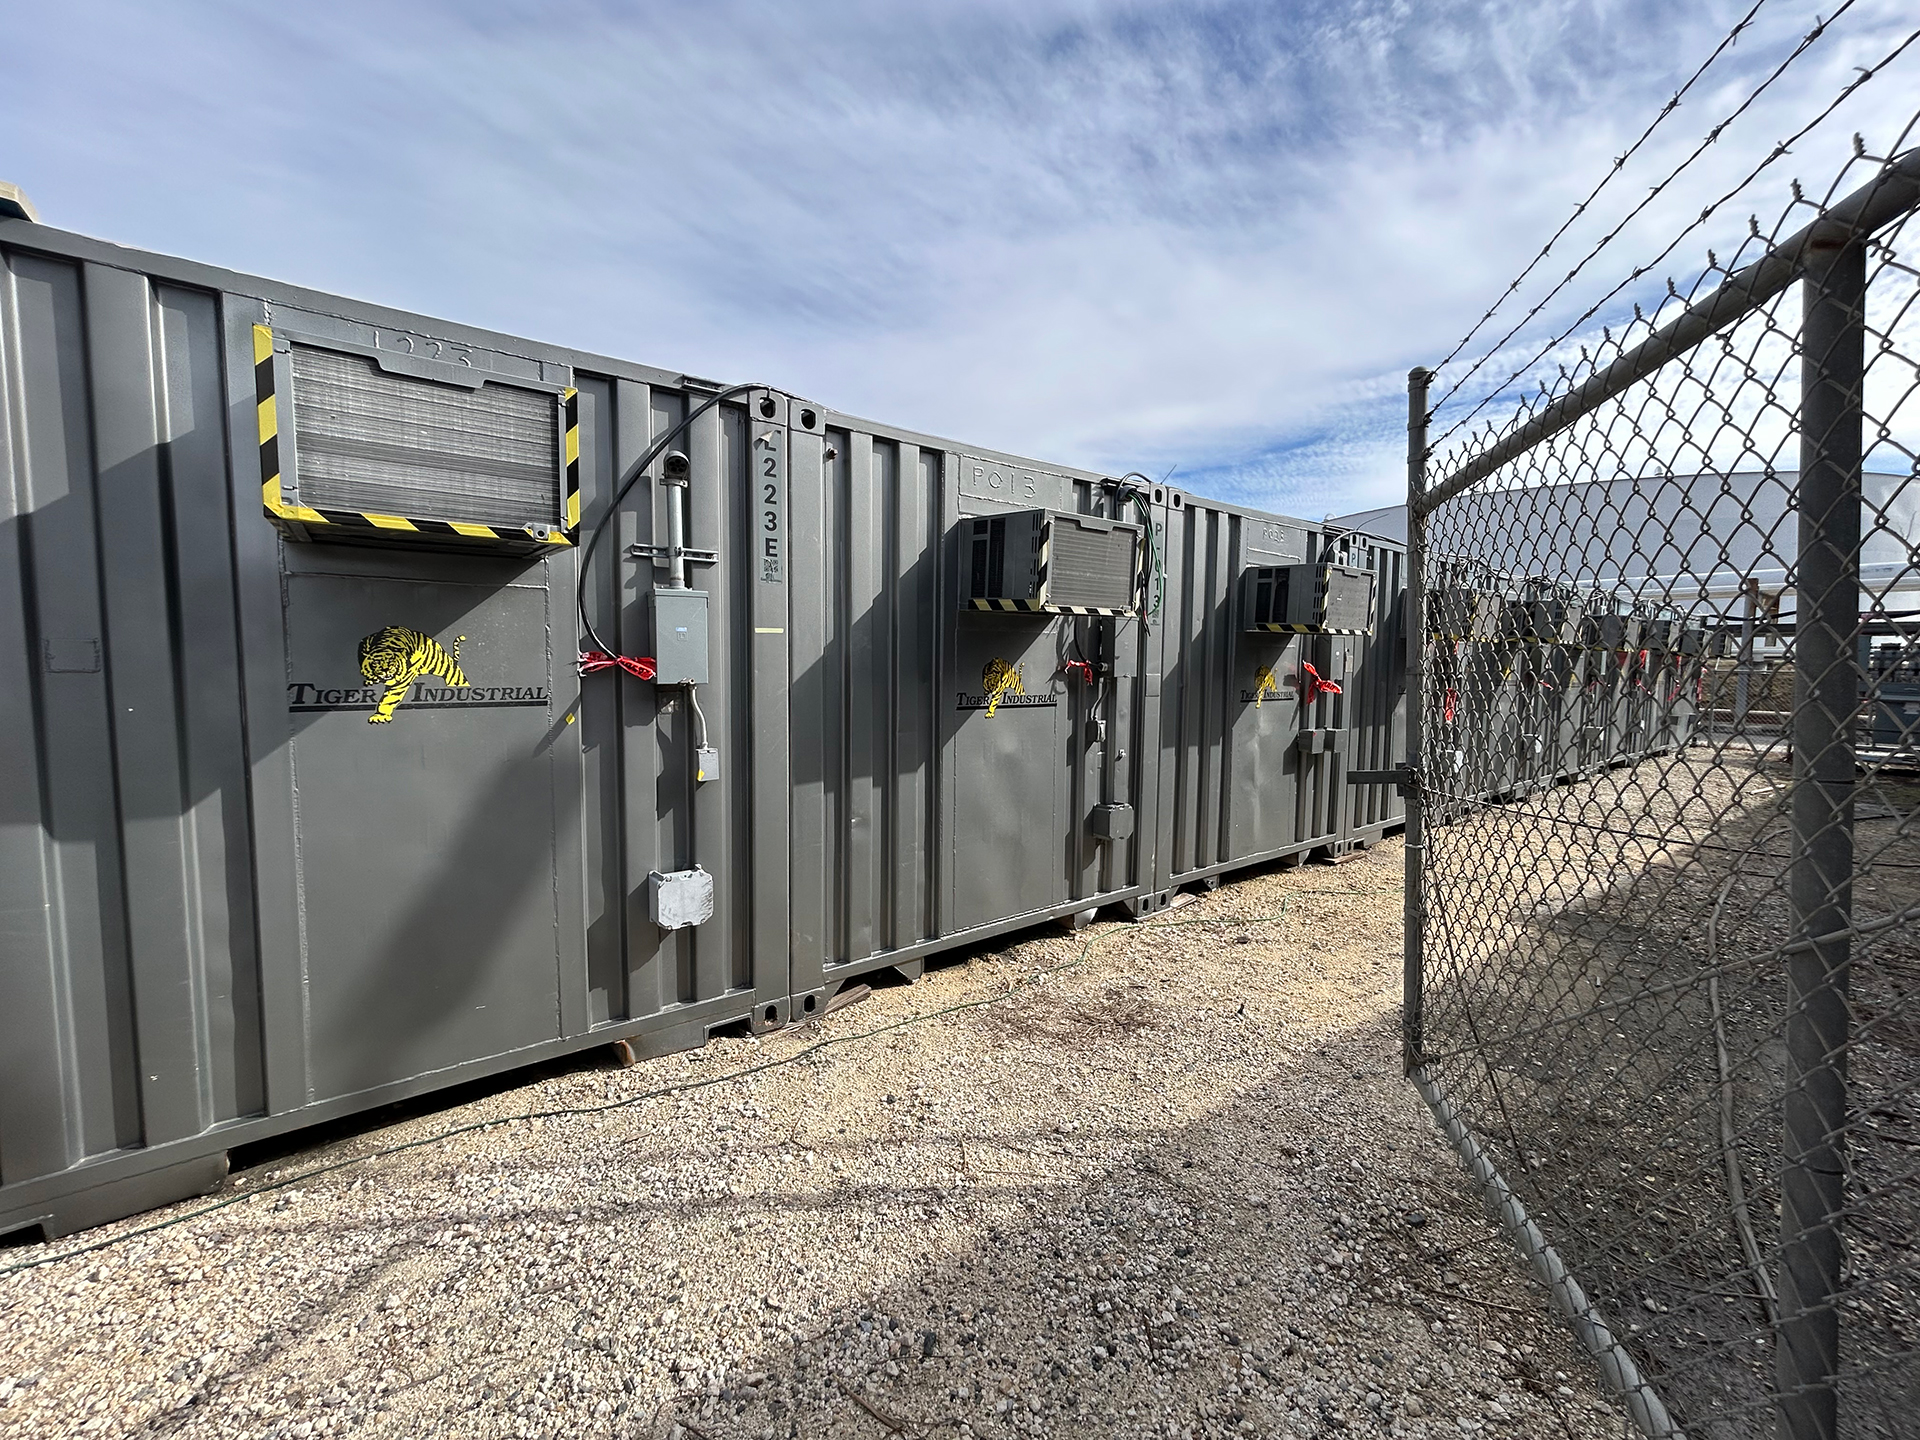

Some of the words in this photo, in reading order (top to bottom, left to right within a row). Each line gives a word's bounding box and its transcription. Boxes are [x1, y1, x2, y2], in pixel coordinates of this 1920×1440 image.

[287, 683, 377, 705] TIGER
[411, 682, 548, 702] INDUSTRIAL
[956, 692, 989, 706] TIGER
[1001, 692, 1057, 704] INDUSTRIAL
